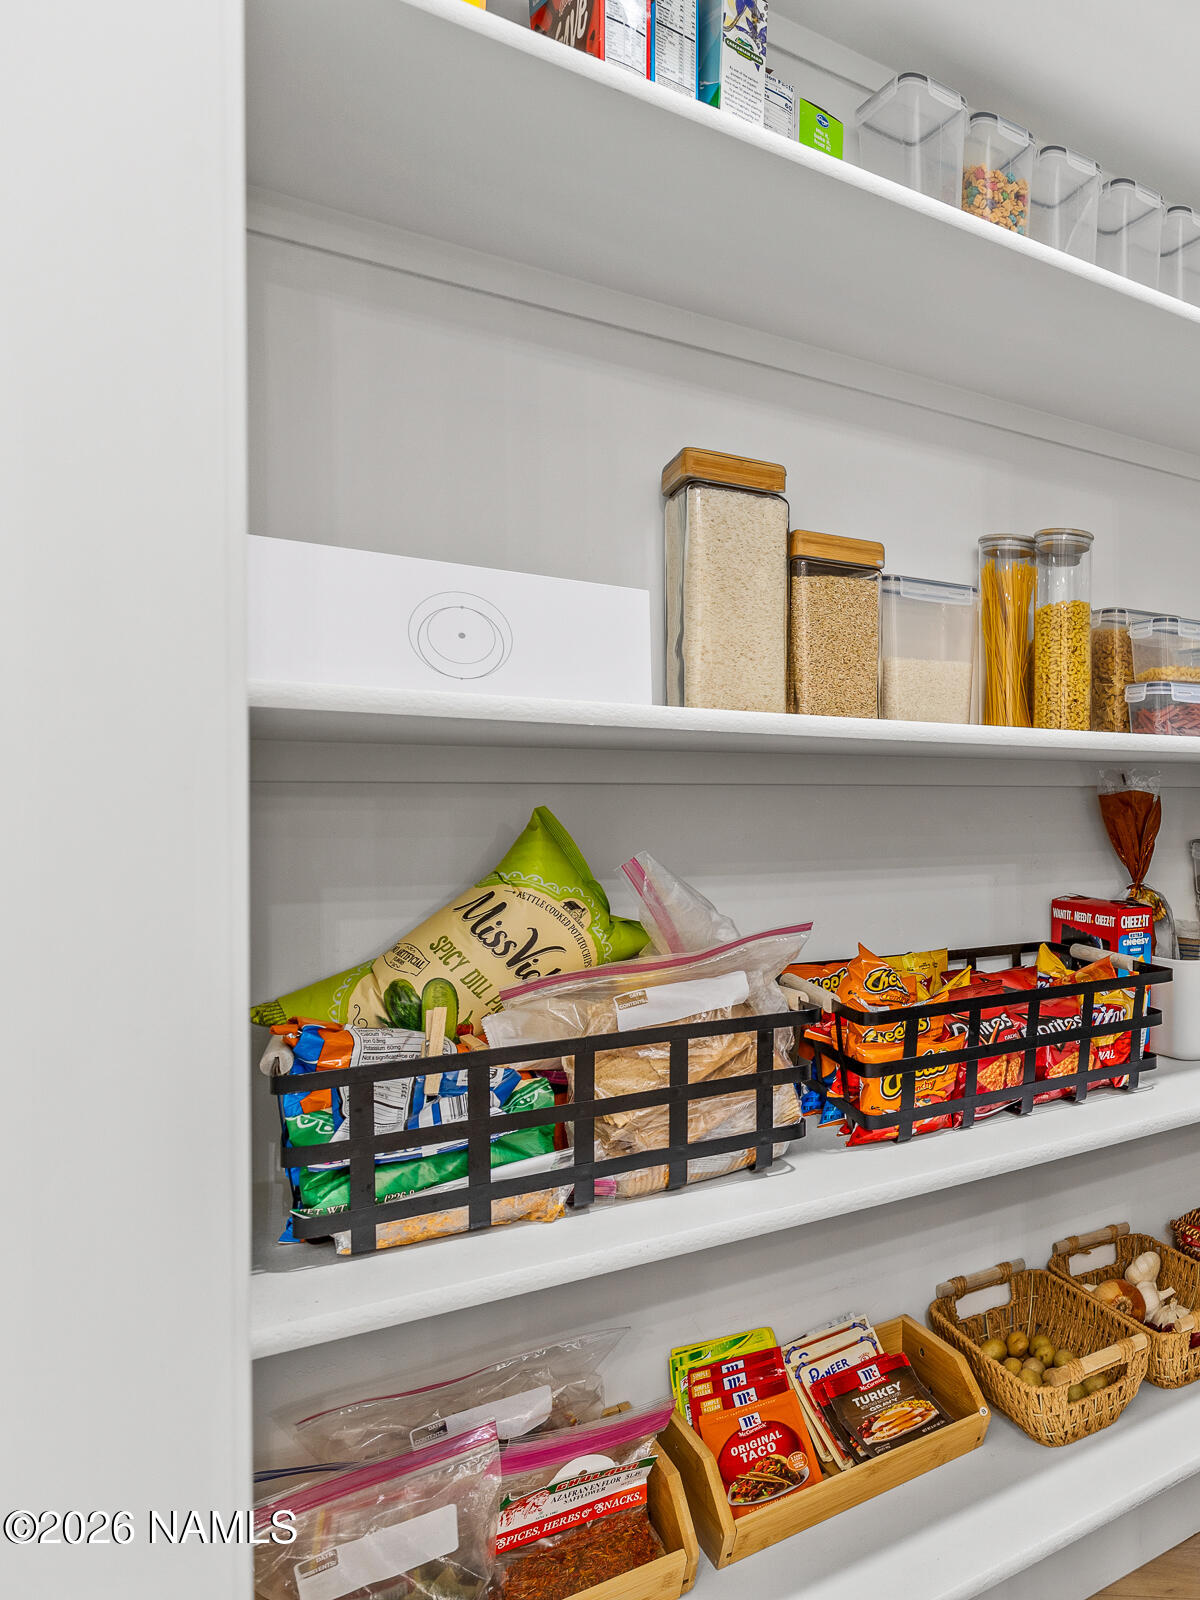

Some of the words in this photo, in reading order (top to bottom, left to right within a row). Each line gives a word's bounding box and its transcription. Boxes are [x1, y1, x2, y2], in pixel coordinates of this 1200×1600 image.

[453, 890, 518, 959] Miss
[516, 891, 547, 909] KETTLE
[544, 903, 571, 930] COOKED
[567, 924, 588, 950] POTATO
[581, 948, 594, 969] CHIPS
[429, 935, 471, 974] SPICY
[459, 968, 494, 1001] DILL
[693, 1382, 711, 1391] SIMPLE
[852, 1380, 901, 1408] TURKEY
[859, 1375, 888, 1391] McCormick
[703, 1398, 720, 1408] SIMPLE
[869, 1397, 899, 1412] GRAVY
[738, 1422, 768, 1437] McCormick
[730, 1430, 783, 1457] ORIGINAL
[740, 1442, 777, 1463] TACO
[551, 1485, 589, 1504] AZAFRAN
[600, 1475, 622, 1488] FLOR
[563, 1486, 607, 1505] SAFFLOWER
[496, 1525, 542, 1550] SPICES,
[542, 1513, 581, 1533] HERBS
